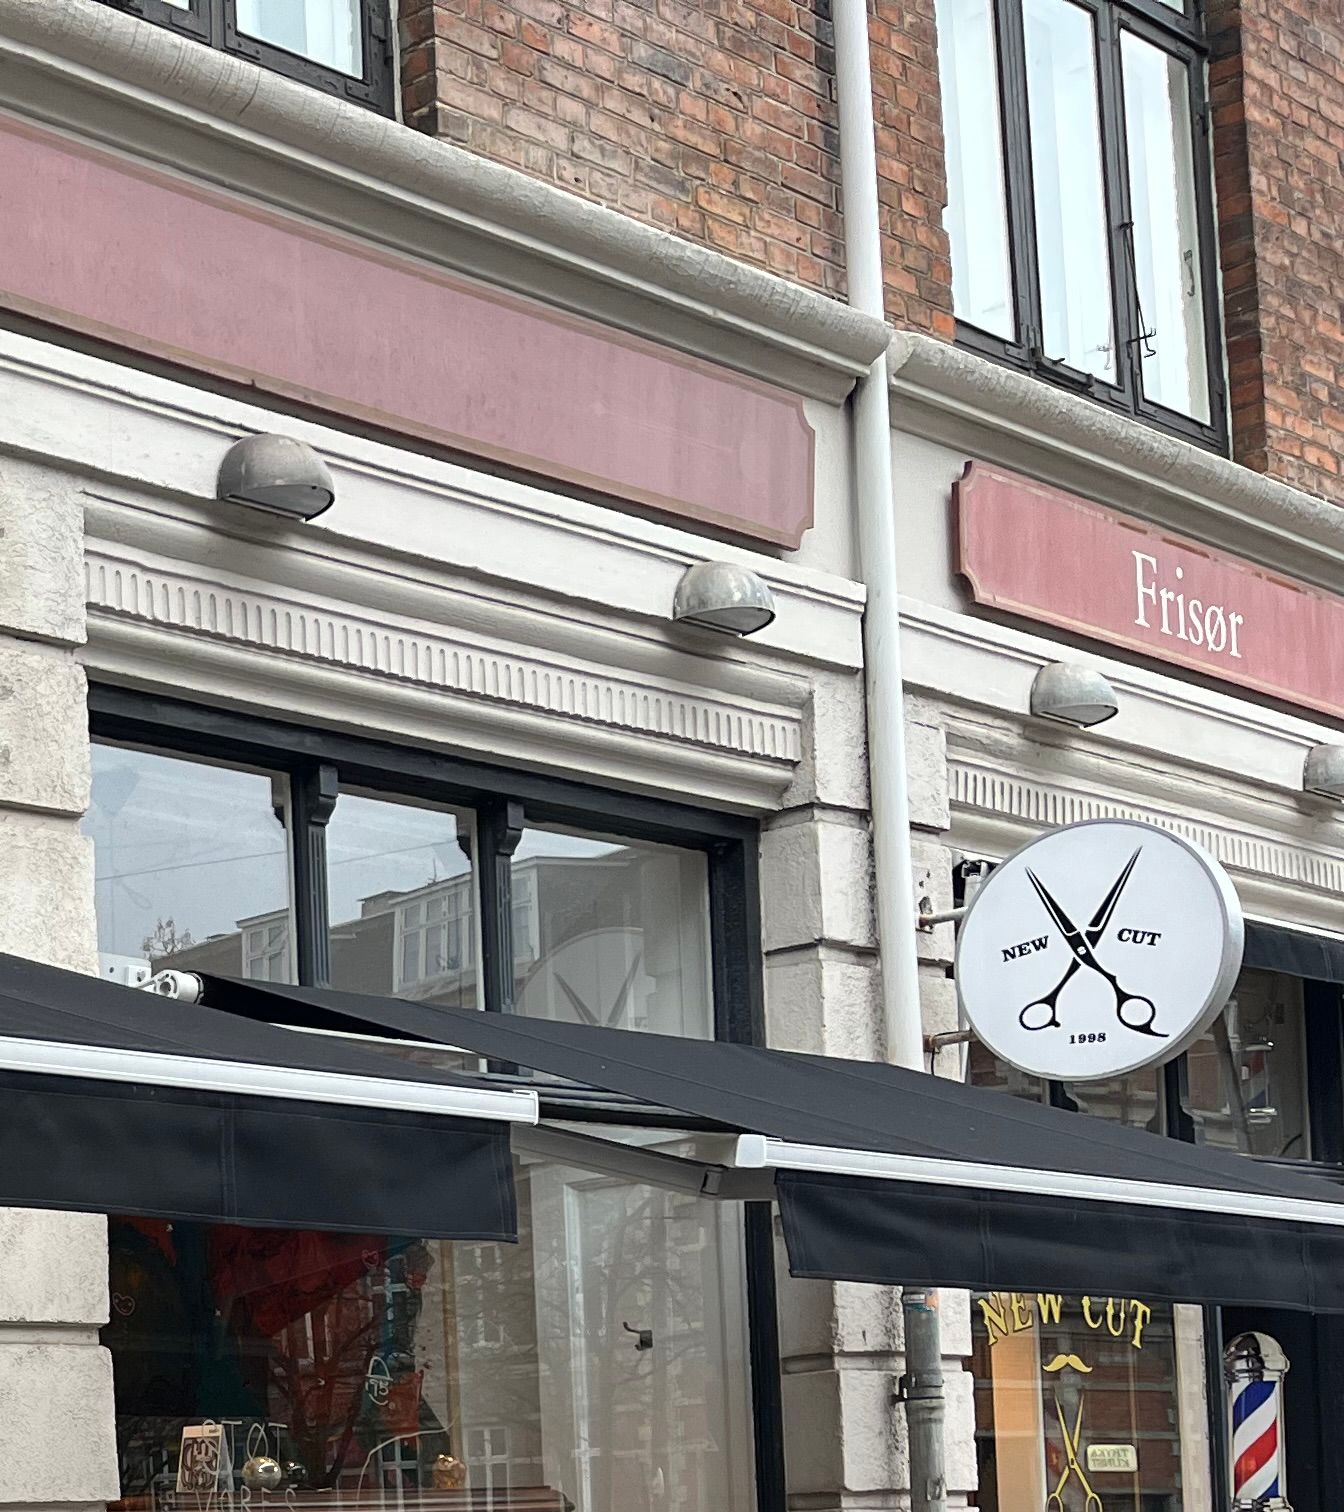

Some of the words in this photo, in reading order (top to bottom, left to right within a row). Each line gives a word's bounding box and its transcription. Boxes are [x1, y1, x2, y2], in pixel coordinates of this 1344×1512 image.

[1131, 549, 1243, 660] Frisør
[1001, 935, 1051, 962] NEW
[1116, 927, 1162, 947] CUT
[1068, 1031, 1107, 1045] 1998
[977, 1292, 1063, 1346] NEW
[1082, 1295, 1151, 1349] CUT
